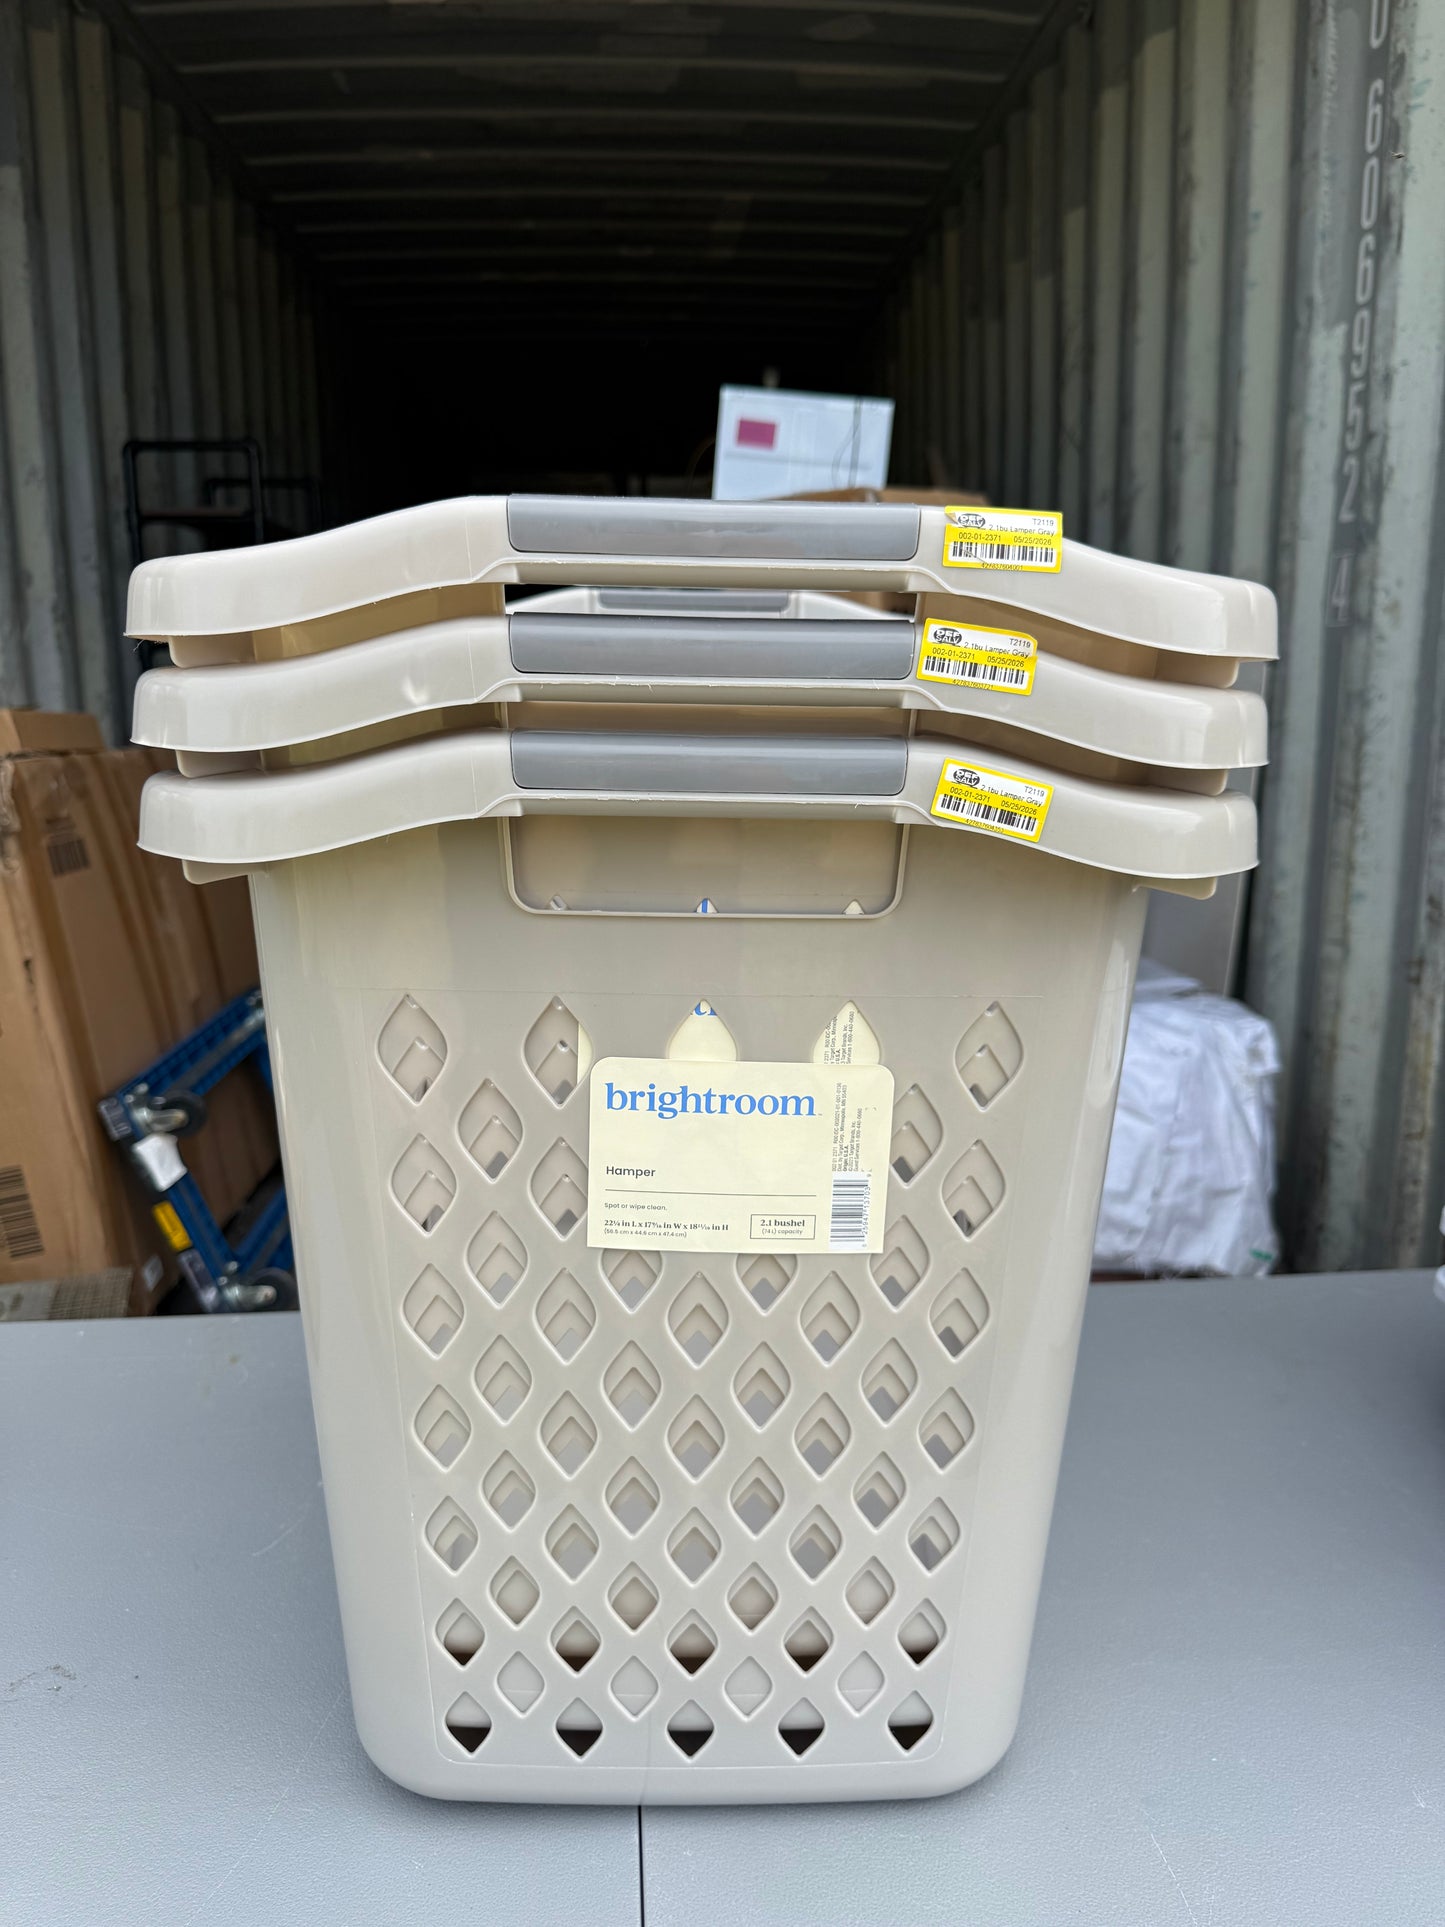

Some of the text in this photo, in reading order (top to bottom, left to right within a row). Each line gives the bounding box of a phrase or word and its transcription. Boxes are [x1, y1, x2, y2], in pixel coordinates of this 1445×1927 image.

[1032, 518, 1054, 526] T2119
[989, 524, 1055, 538] 2.1bu Lamper Gray
[958, 532, 1052, 546] 002-01-2371 05/25/2026
[1009, 638, 1031, 648] T2119
[932, 647, 1025, 668] 002-01-2371 05/25/2026
[964, 642, 1030, 660] 2.1bu Lamper Gray
[980, 784, 1044, 808] 2.1bu Lamper Gray
[1024, 786, 1045, 798] T2119
[950, 786, 1038, 816] 002-01-2371 05/25/2026
[605, 1082, 817, 1120] brightroom
[606, 1166, 656, 1179] Hamper
[604, 1202, 620, 1210] Spot
[630, 1203, 646, 1211] wipe
[774, 1219, 805, 1227] bushel
[778, 1228, 803, 1236] capacity
